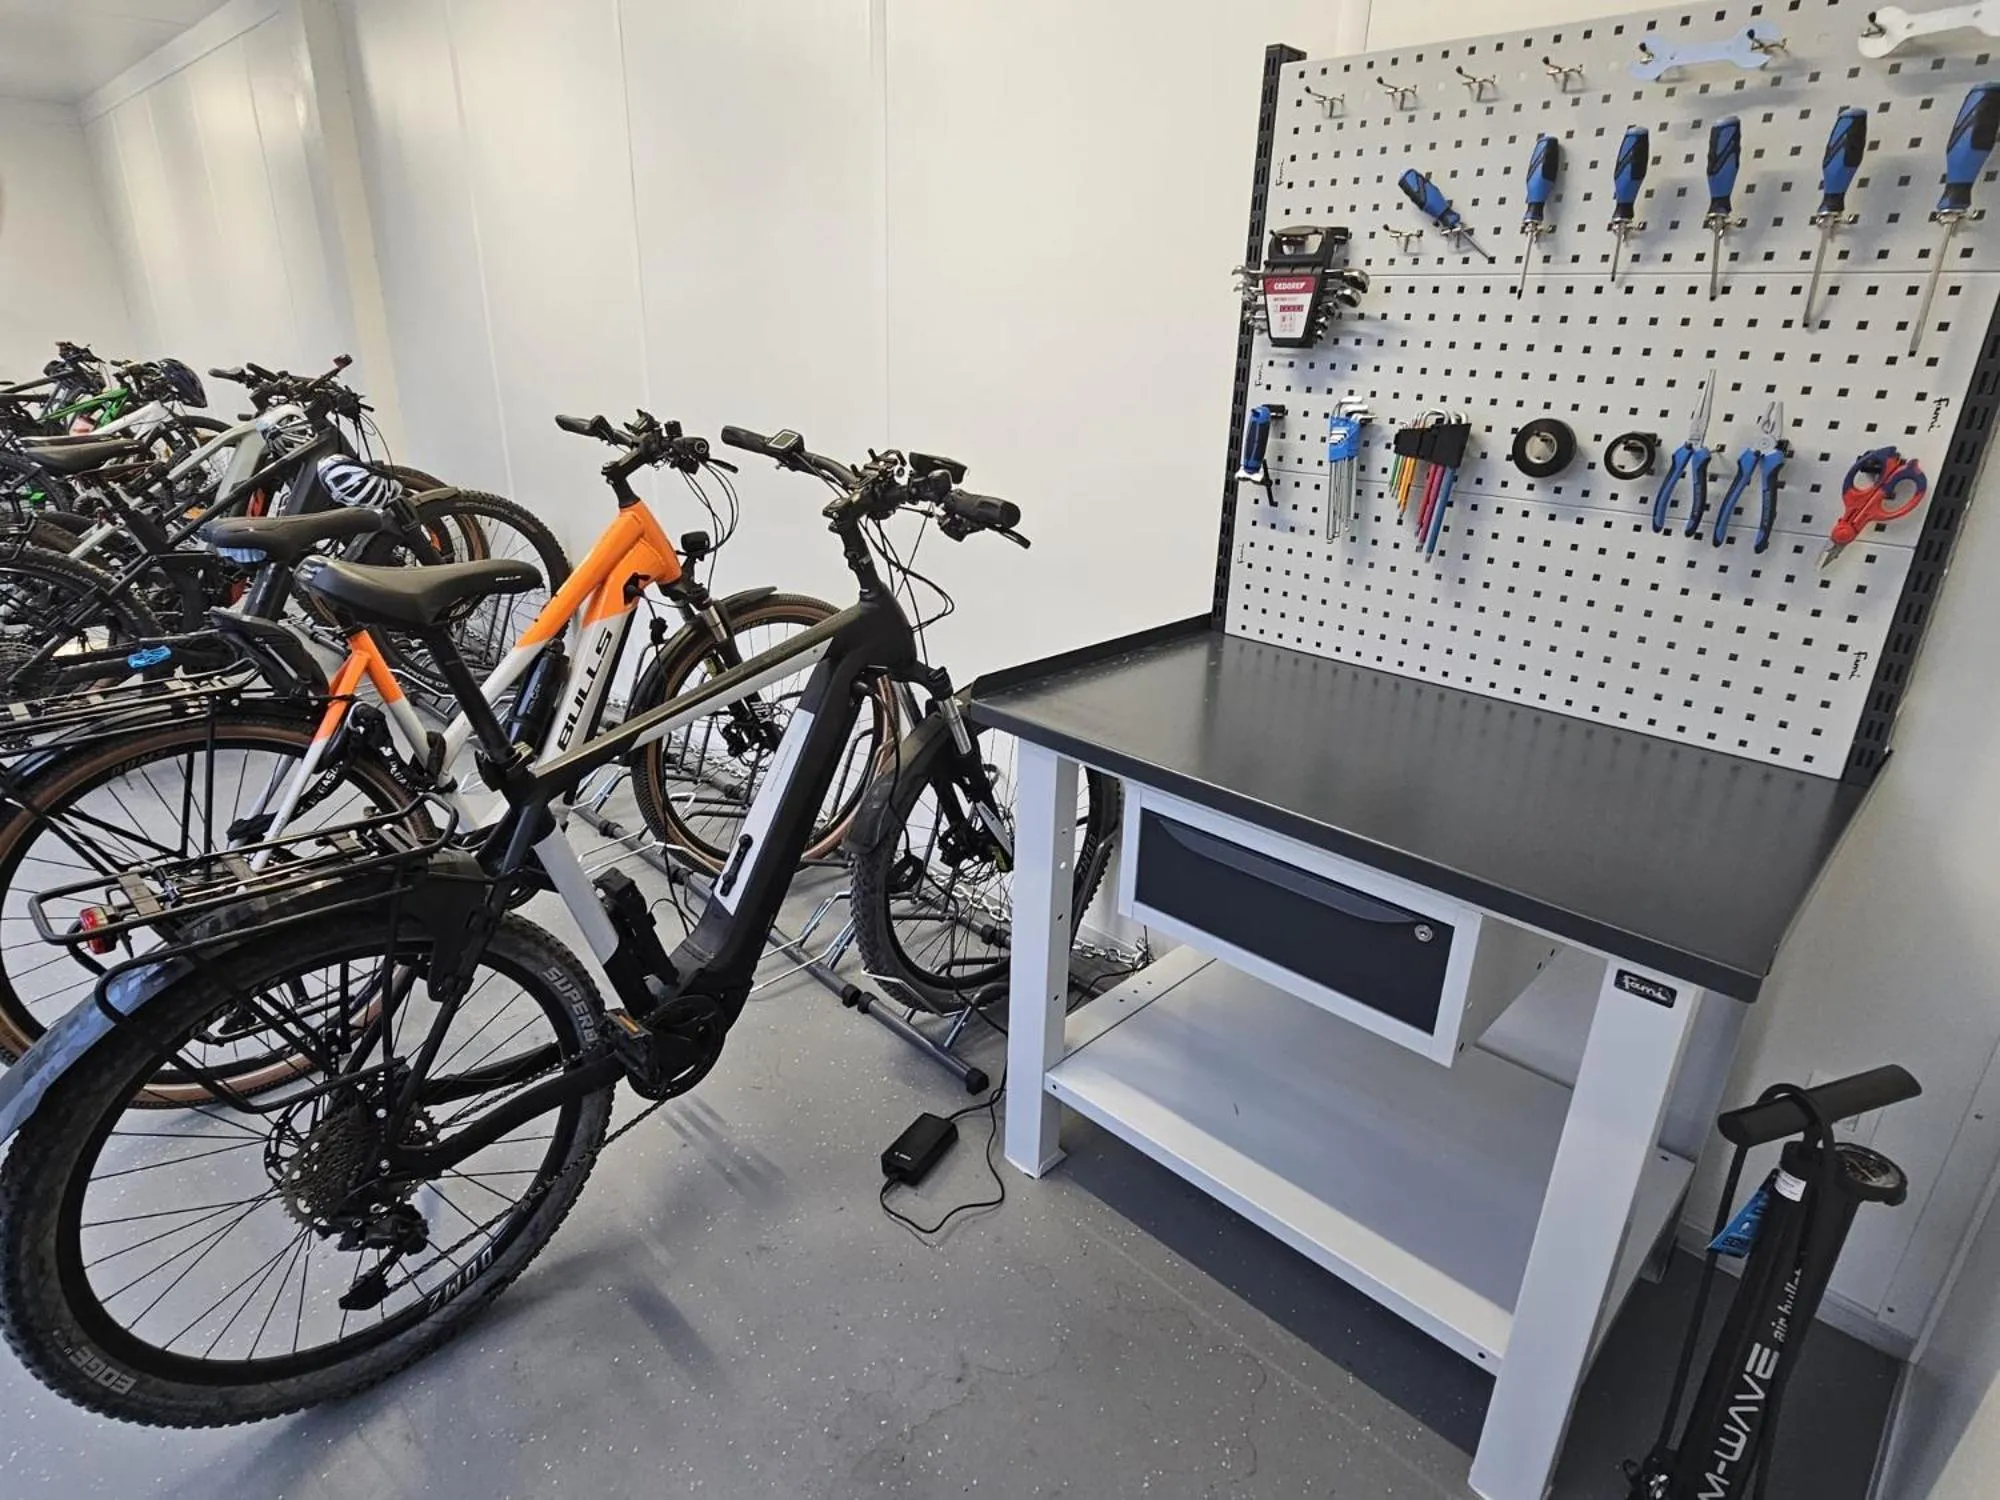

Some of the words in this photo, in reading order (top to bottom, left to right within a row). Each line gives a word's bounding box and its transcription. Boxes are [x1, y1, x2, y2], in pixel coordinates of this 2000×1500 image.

[557, 627, 613, 752] BULLS
[68, 1344, 137, 1395] EDGE
[1697, 1341, 1781, 1500] M-WAVE
[1771, 1316, 1789, 1342] air
